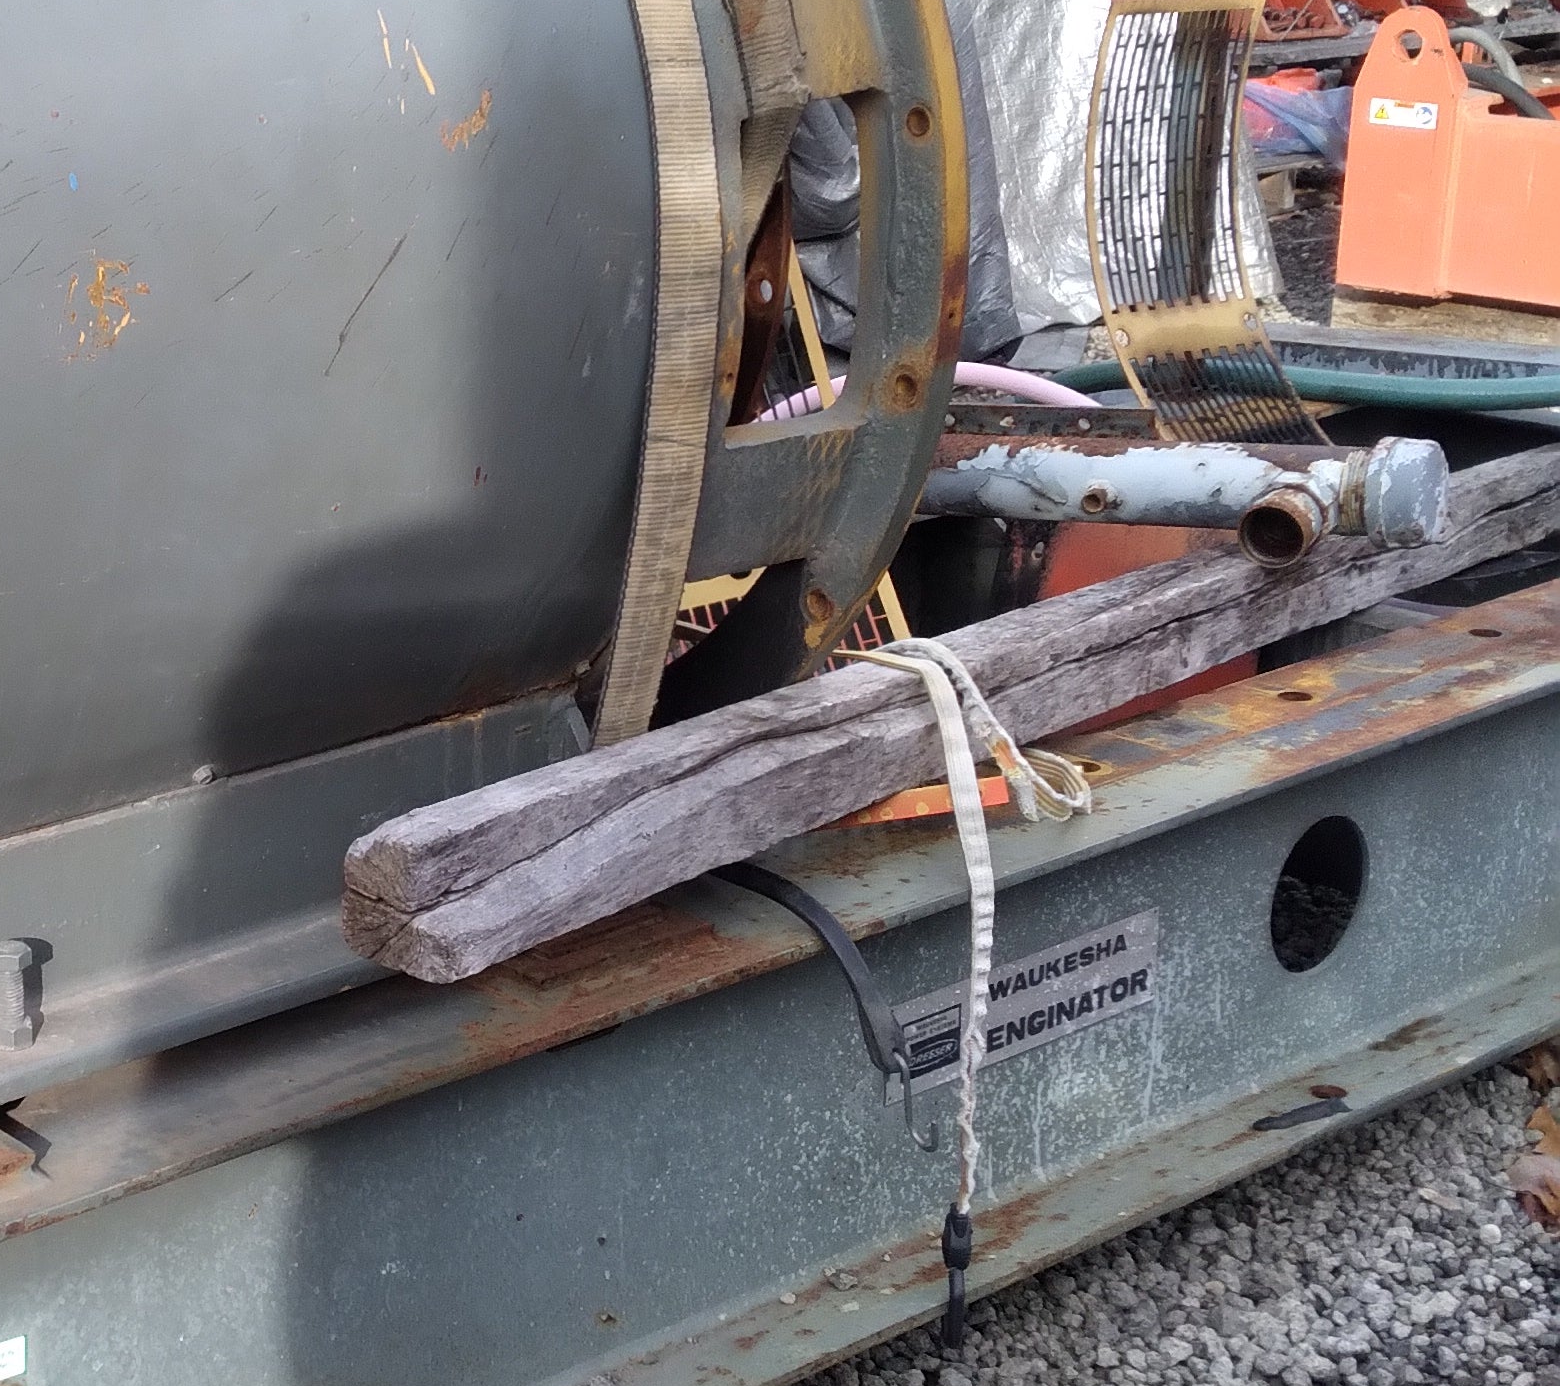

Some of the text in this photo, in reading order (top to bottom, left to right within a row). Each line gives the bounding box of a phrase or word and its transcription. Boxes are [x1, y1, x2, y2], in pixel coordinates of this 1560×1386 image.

[988, 934, 1128, 1001] WAUKESHA
[987, 968, 1149, 1053] ENGINATOR
[909, 1042, 954, 1067] DRESSER
